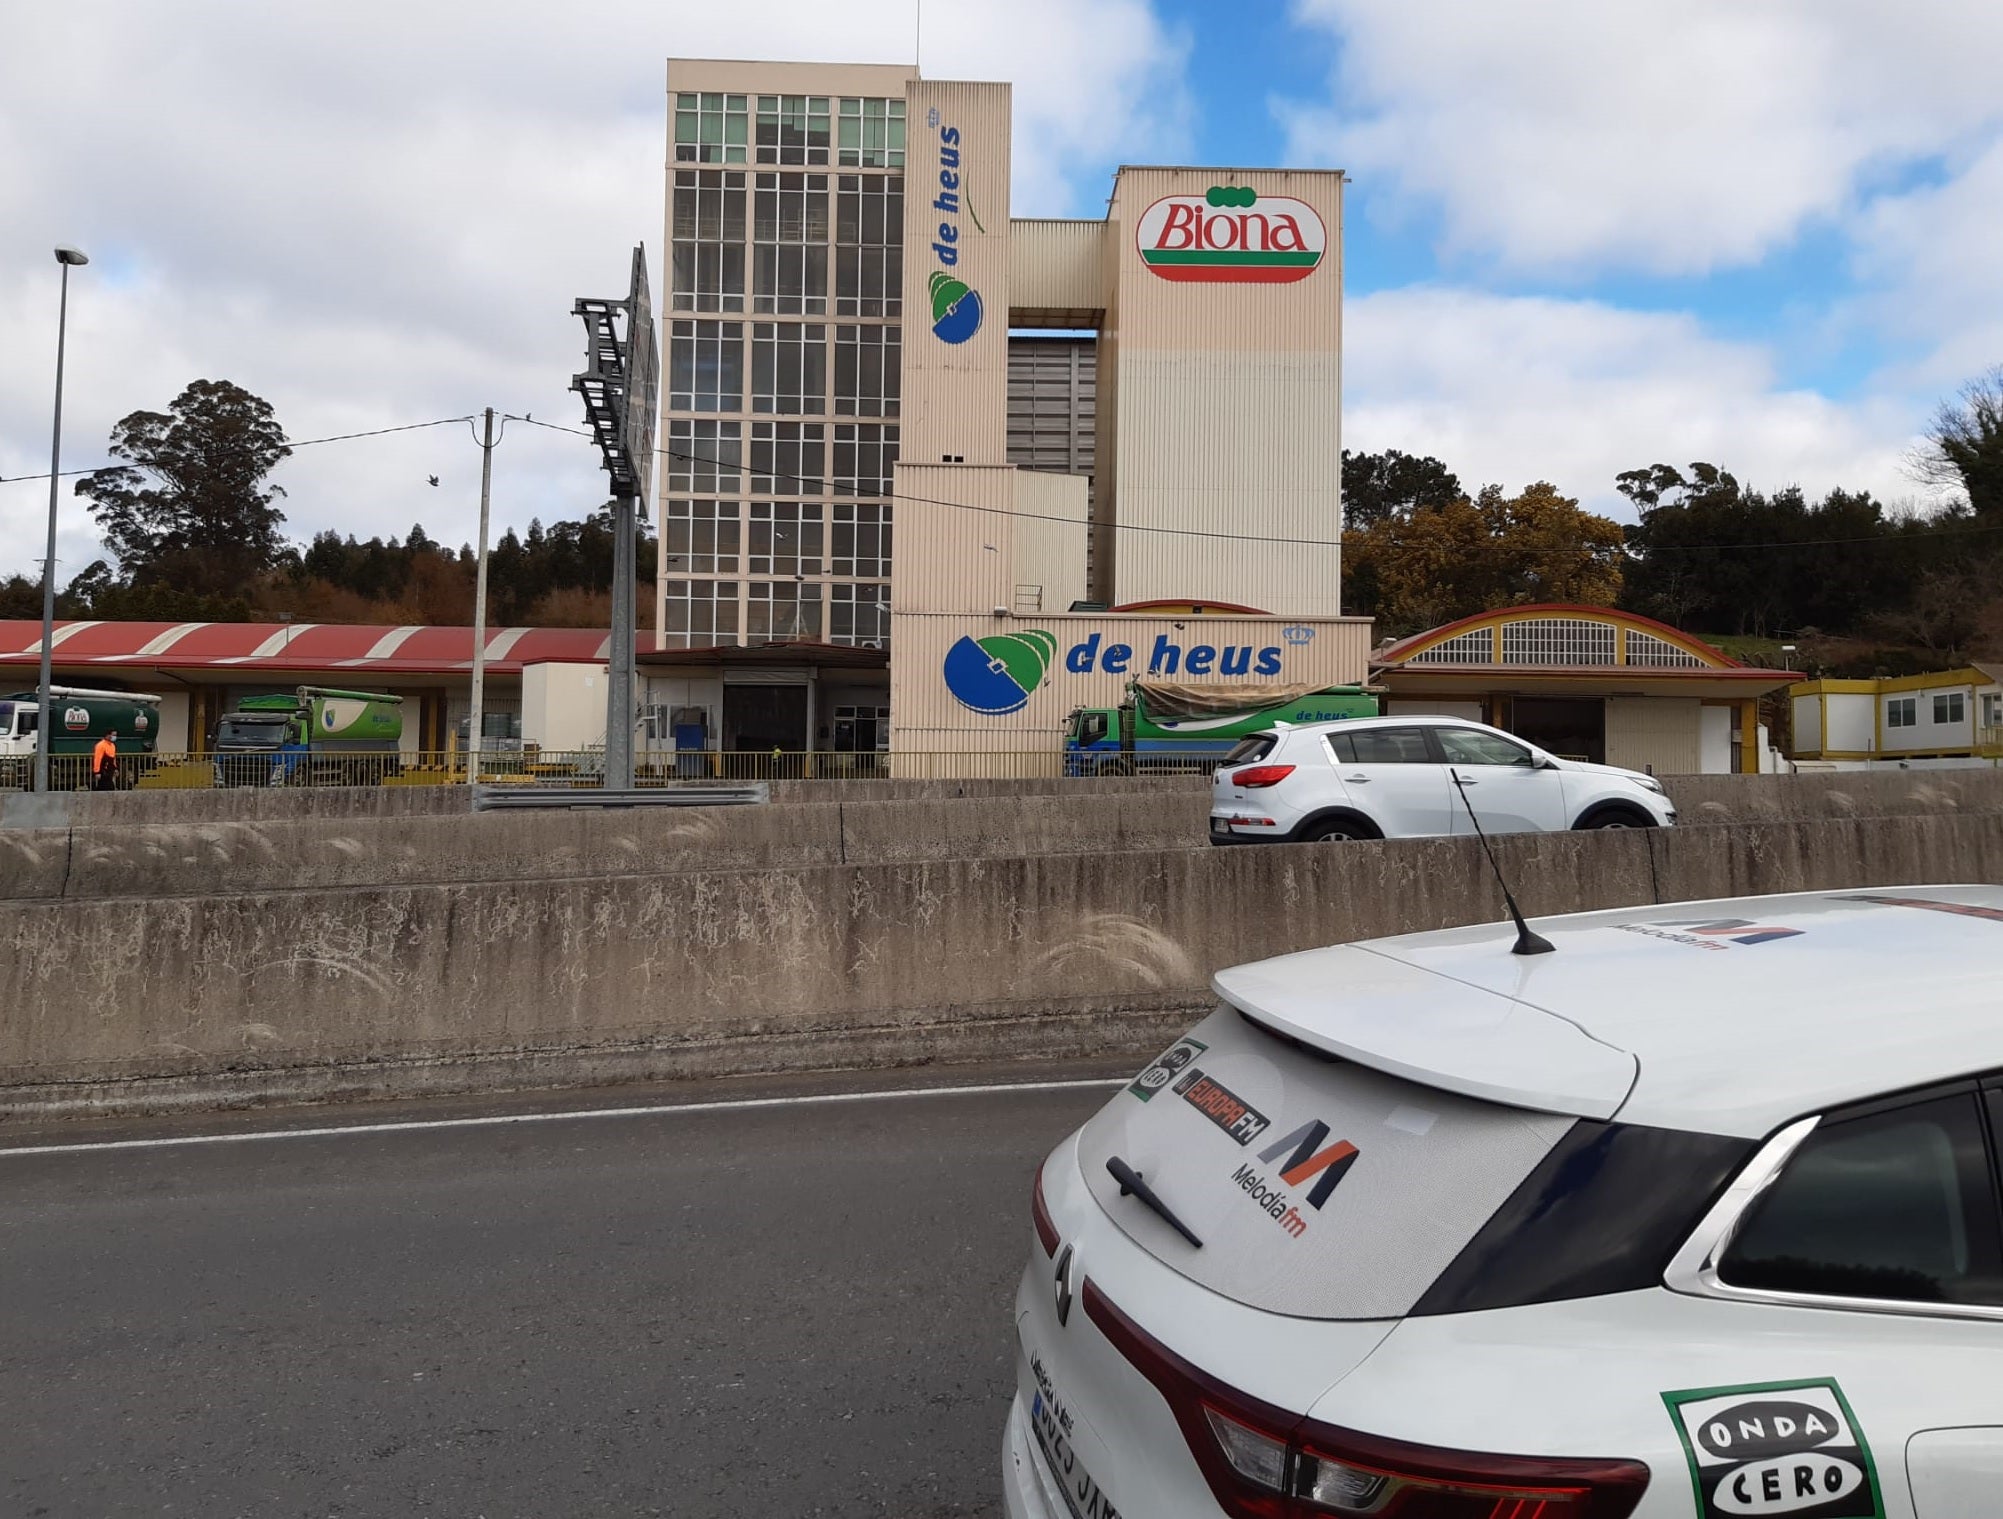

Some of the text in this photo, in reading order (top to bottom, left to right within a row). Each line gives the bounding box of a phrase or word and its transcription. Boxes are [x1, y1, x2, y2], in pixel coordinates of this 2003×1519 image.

[932, 126, 961, 266] de heus
[1155, 203, 1309, 251] Biona
[1065, 633, 1283, 676] de heus
[1296, 710, 1348, 721] de heus
[1709, 1412, 1828, 1448] ONDA
[1732, 1464, 1843, 1504] CERO
